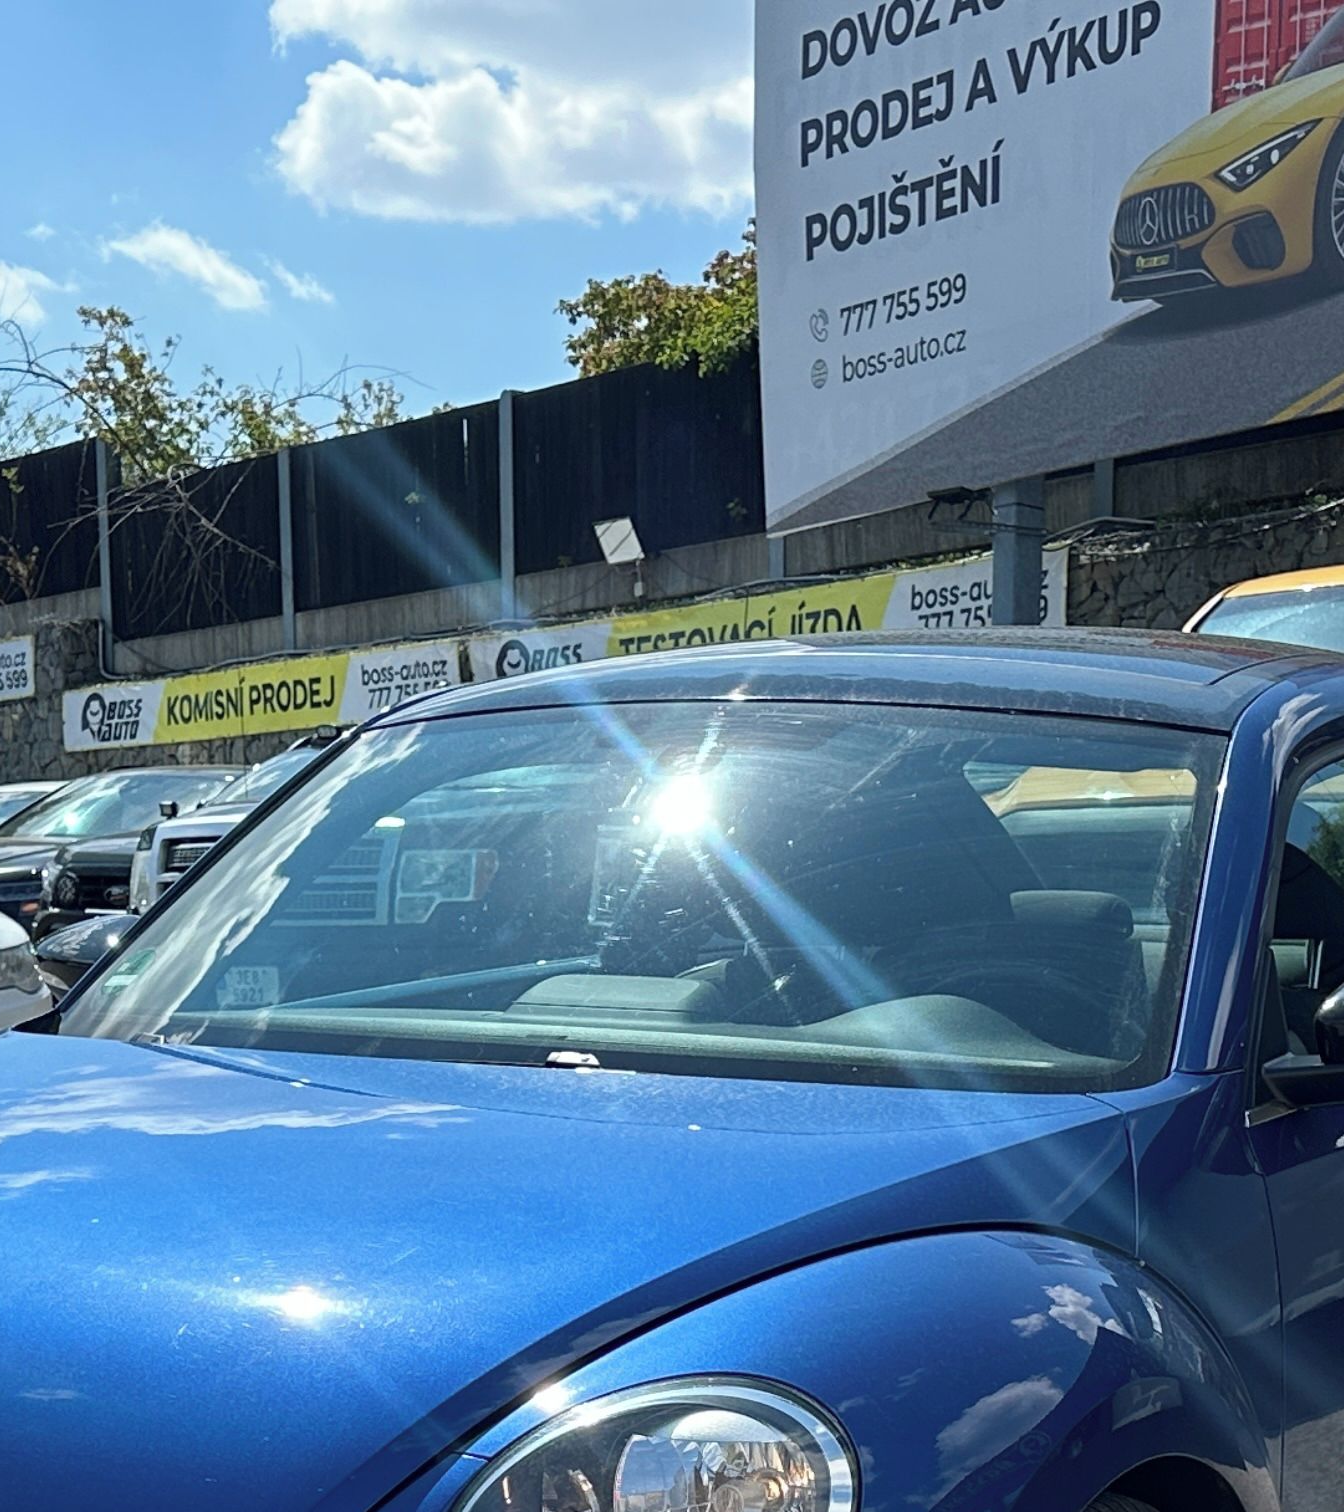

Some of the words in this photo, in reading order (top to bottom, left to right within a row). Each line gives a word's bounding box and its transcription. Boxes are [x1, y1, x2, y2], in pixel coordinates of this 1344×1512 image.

[801, 0, 940, 80] DOVOZ
[800, 69, 954, 168] PRODEJ
[964, 57, 998, 112] A
[1006, 0, 1161, 95] VÝKUP
[804, 138, 1006, 261] POJIŠTĚNÍ
[839, 298, 878, 337] 777
[882, 286, 920, 324] 755
[925, 272, 967, 311] 599
[842, 328, 967, 383] boss-auto.cz
[918, 610, 954, 628] 777
[959, 604, 993, 627] 75
[360, 659, 448, 686] boss-auto.cz
[368, 686, 392, 710] 777
[105, 698, 143, 721] BOSS
[165, 676, 247, 726] KOMISNÍ
[248, 675, 336, 716] PRODEJ
[98, 719, 140, 742] AUTO
